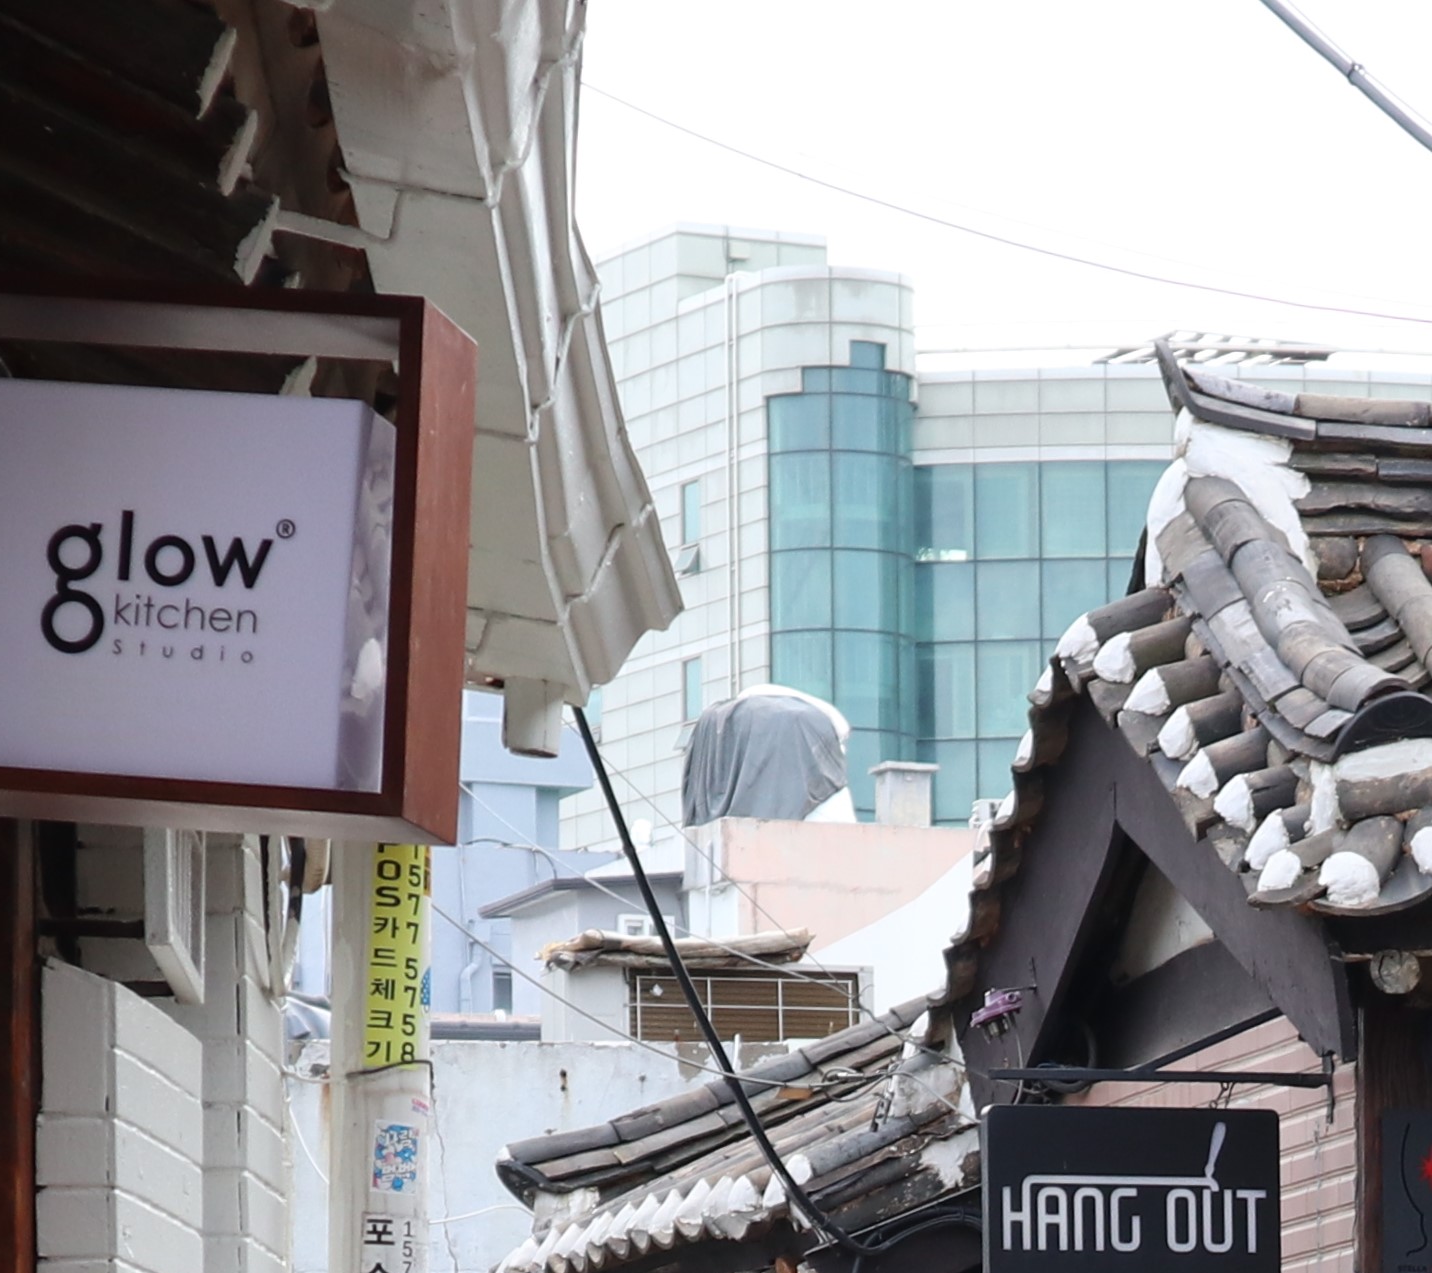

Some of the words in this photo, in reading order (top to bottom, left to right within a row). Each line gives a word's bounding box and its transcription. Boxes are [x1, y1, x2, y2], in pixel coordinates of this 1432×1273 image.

[113, 594, 258, 636] kitchen
[113, 639, 255, 665] Studio
[1002, 1175, 1141, 1252] HANG
[1166, 1187, 1267, 1254] OUT
